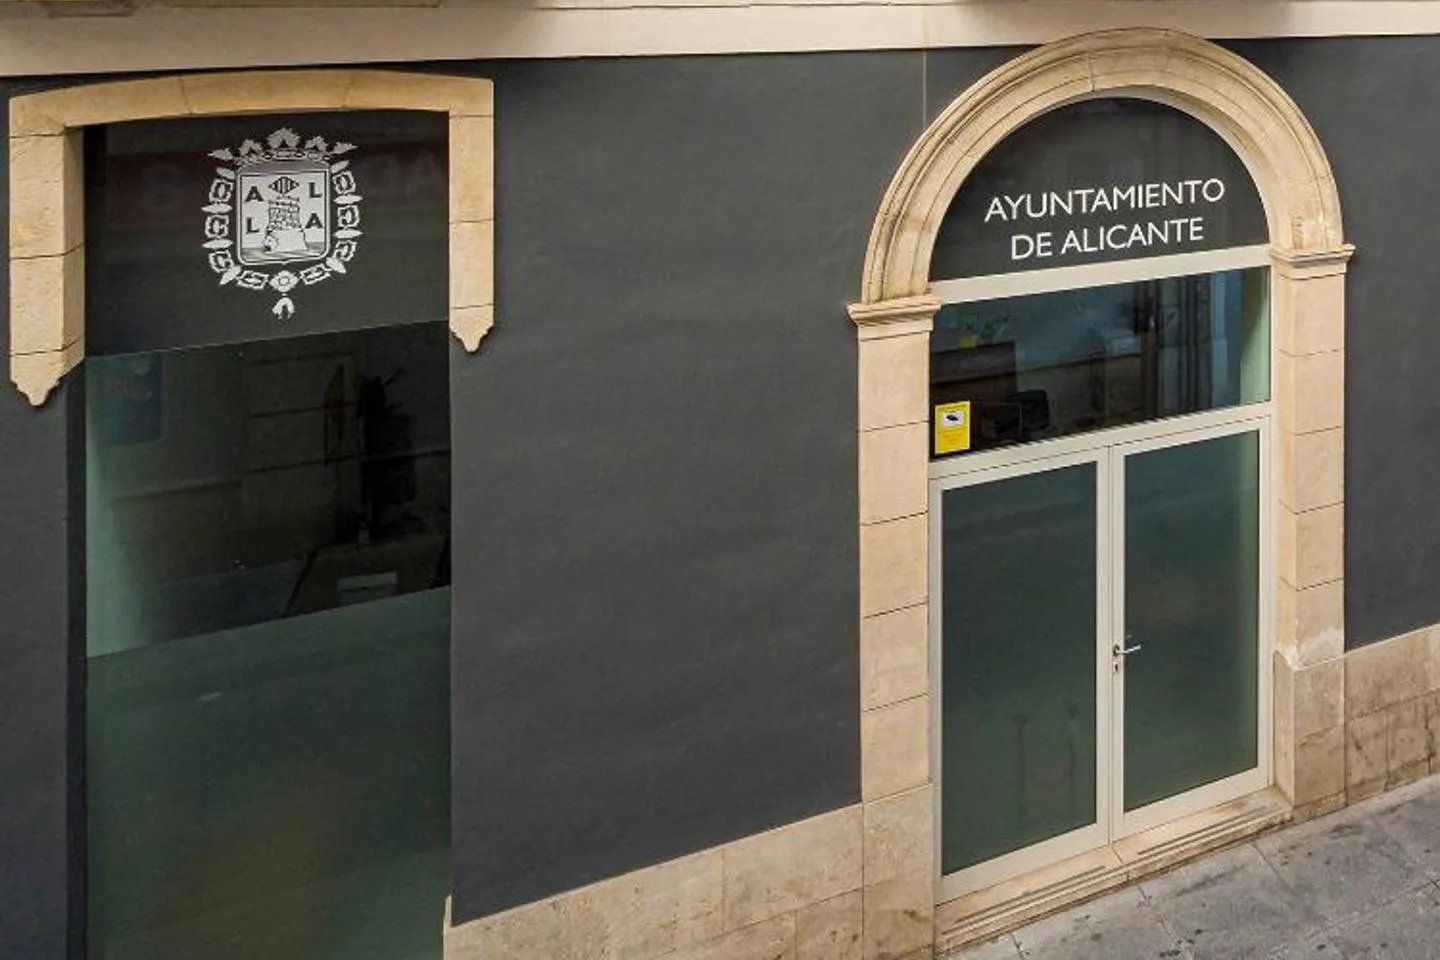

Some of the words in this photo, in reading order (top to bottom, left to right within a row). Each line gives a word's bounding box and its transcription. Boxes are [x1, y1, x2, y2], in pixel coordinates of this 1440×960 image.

[245, 186, 263, 201] A
[308, 182, 321, 198] L
[984, 178, 1225, 222] AYUNTAMIENTO
[246, 217, 259, 233] L
[305, 213, 322, 228] A
[1010, 232, 1053, 260] DE
[1060, 217, 1204, 255] ALICANTE
